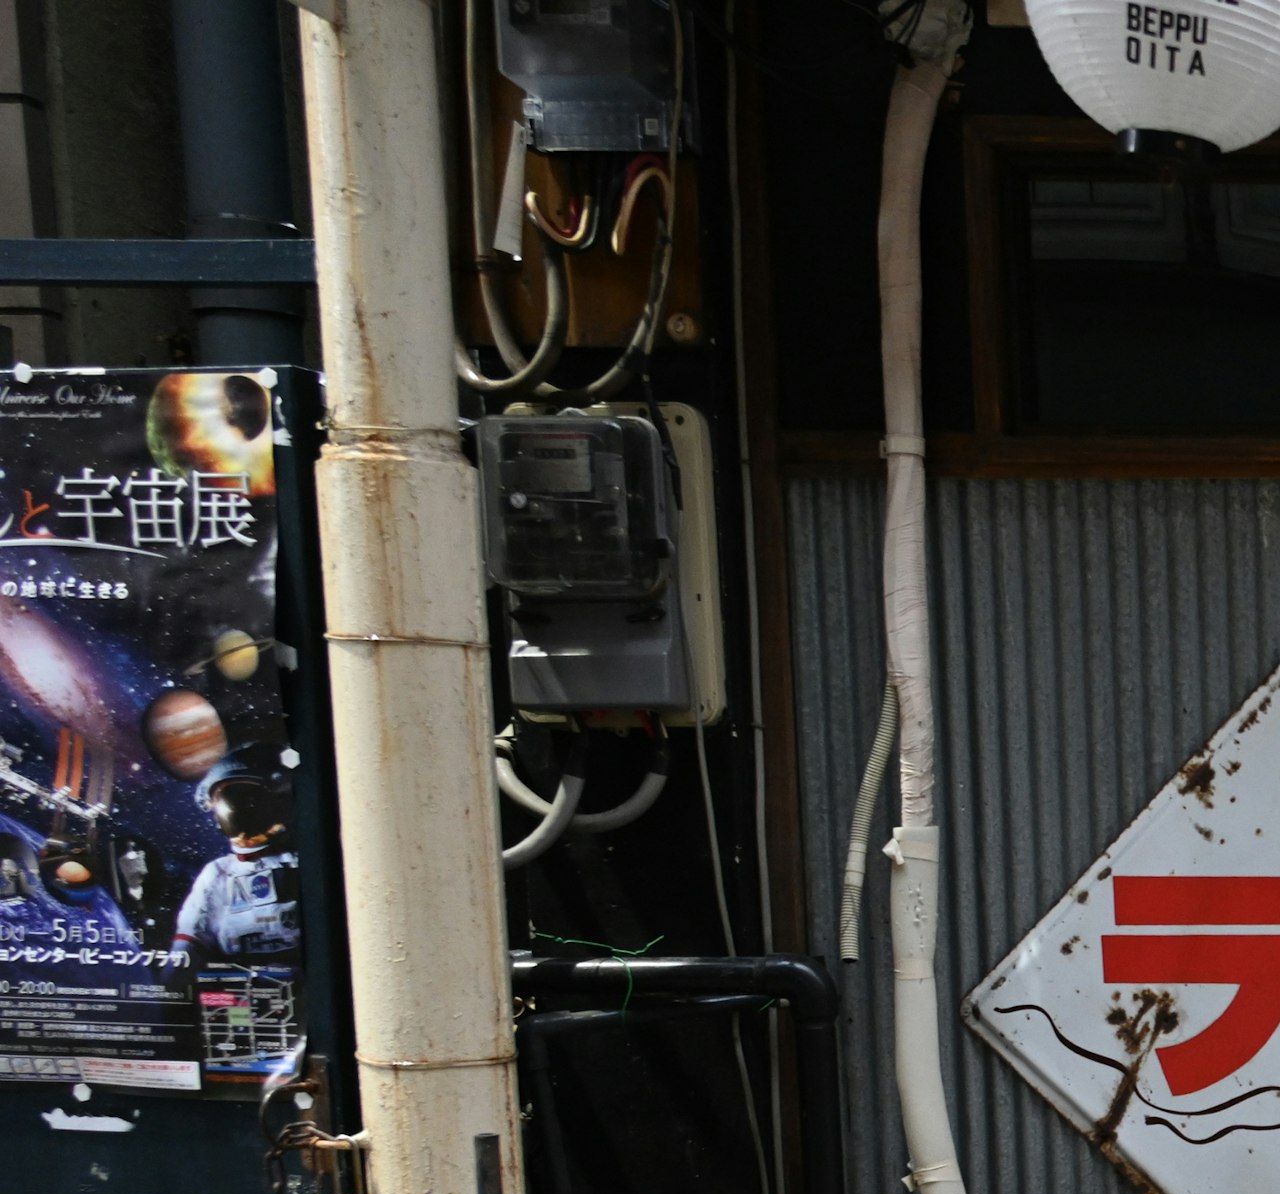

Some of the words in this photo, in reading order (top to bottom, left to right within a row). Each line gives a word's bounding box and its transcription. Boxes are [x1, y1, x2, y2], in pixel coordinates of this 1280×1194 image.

[1127, 3, 1208, 45] BEPPU
[1126, 37, 1206, 77] OITA
[0, 467, 258, 548] と宇宙展
